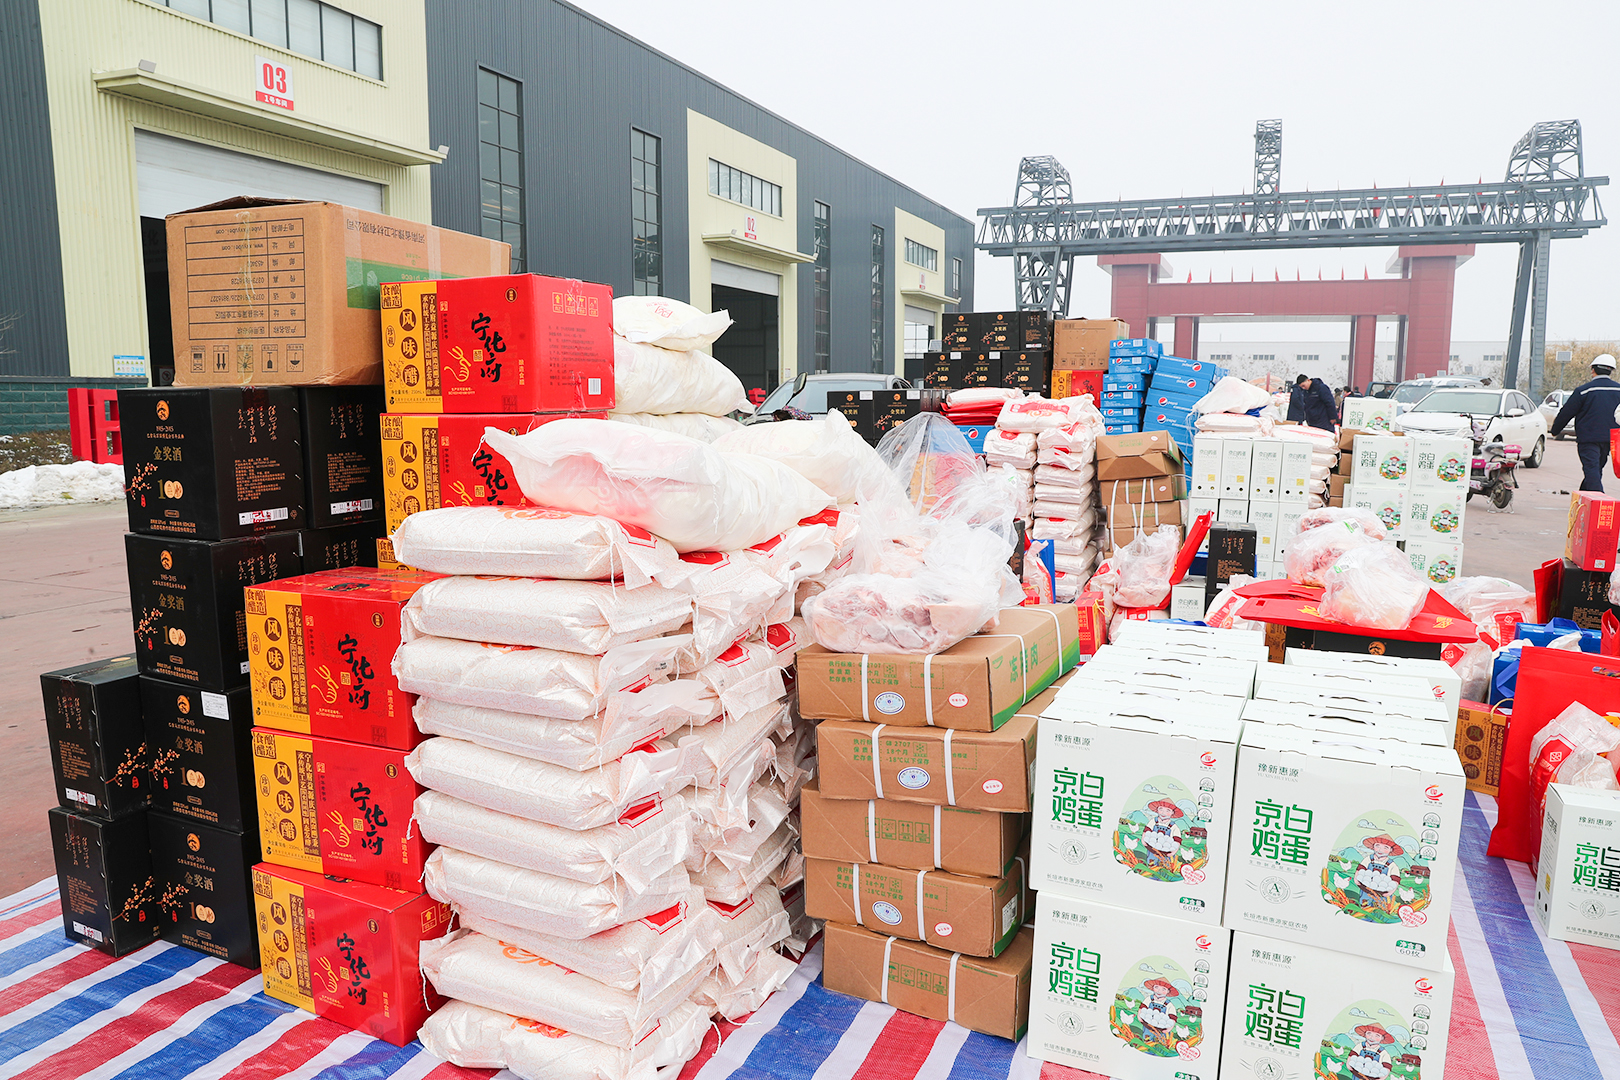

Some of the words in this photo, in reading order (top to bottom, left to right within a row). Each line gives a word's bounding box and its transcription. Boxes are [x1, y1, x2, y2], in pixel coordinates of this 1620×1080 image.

[263, 63, 286, 94] 03
[346, 218, 425, 244] 河南省豫北卫材有限公司
[748, 217, 754, 232] 02
[153, 446, 182, 462] 金奖酒
[158, 593, 184, 611] 金奖酒
[175, 736, 204, 755] 金奖酒
[1054, 734, 1092, 747] 豫新惠源
[886, 756, 930, 765] -18℃以下保存
[1258, 763, 1299, 777] 豫新惠源
[1052, 767, 1104, 799] 京白
[1052, 795, 1104, 829] 鸡蛋
[1252, 798, 1314, 834] 京白
[1250, 828, 1311, 866] 鸡蛋
[1574, 842, 1620, 868] 京白
[184, 872, 214, 892] 金奖酒
[866, 880, 885, 889] 18个月
[873, 874, 888, 882] 2707
[1572, 864, 1620, 892] 鸡蛋
[1182, 898, 1204, 907] 净含量
[1182, 906, 1201, 914] 60枚
[1052, 910, 1088, 924] 豫新惠源
[1400, 941, 1422, 950] 净含量
[1400, 949, 1420, 958] 60枚
[1050, 942, 1101, 974] 京白
[1252, 949, 1292, 964] 豫新惠源
[1048, 968, 1100, 1004] 鸡蛋
[1247, 983, 1306, 1018] 京白
[1244, 1010, 1304, 1049] 鸡蛋
